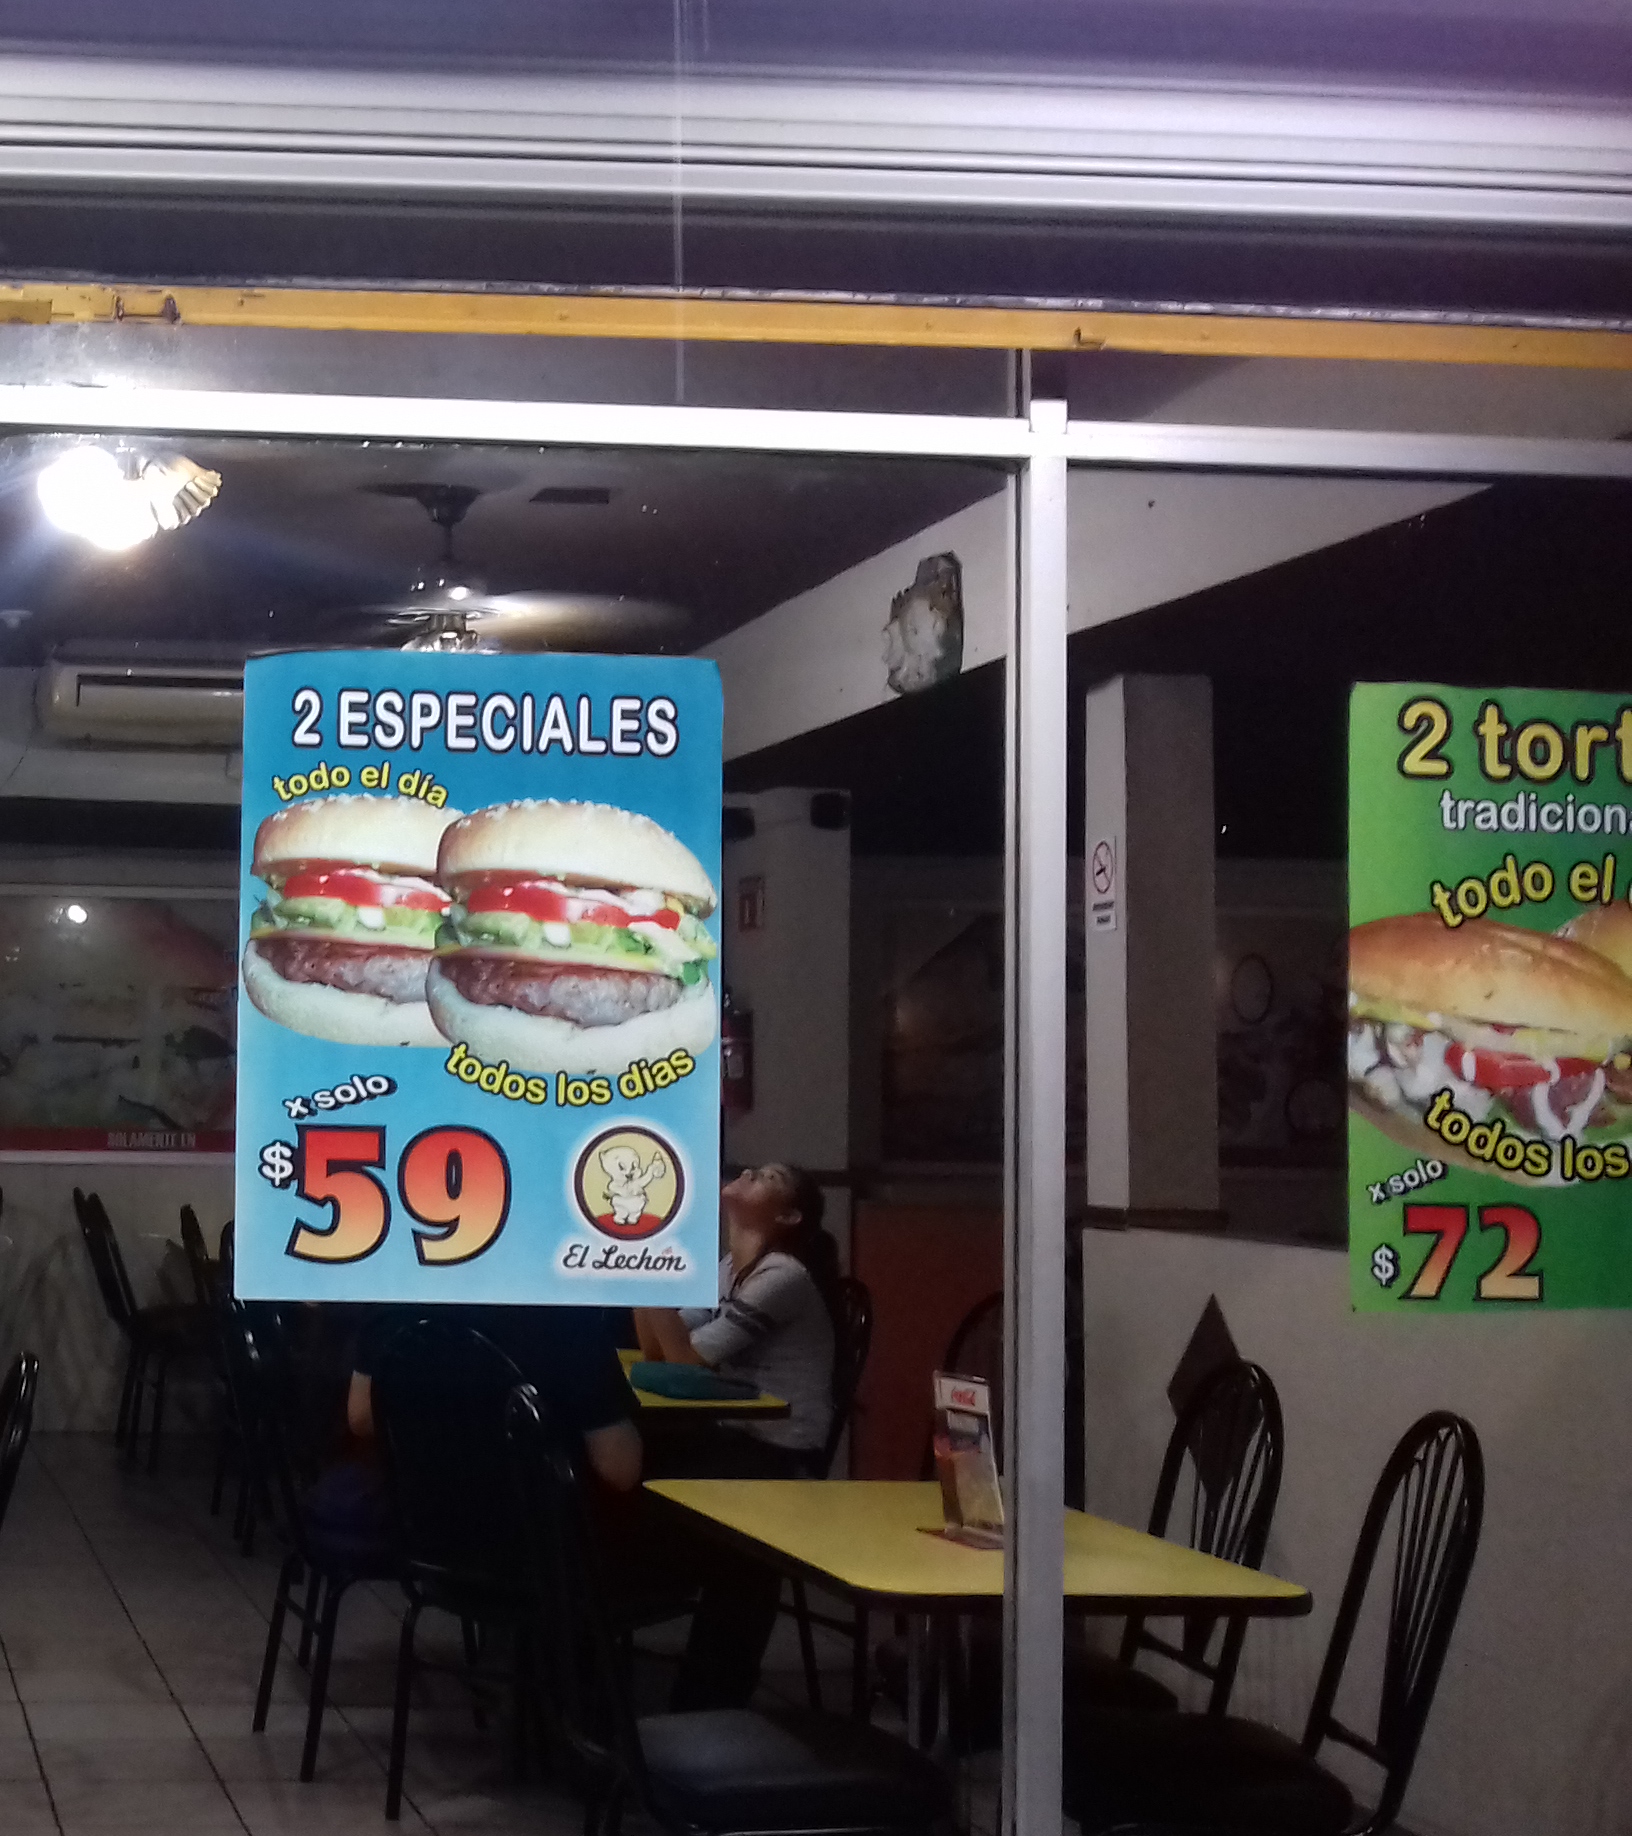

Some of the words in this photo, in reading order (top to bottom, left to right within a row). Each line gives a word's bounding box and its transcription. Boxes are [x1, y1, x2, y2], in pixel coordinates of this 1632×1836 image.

[292, 686, 323, 748] 2
[337, 687, 679, 757] ESPECIALES
[1398, 697, 1452, 780] 2
[1473, 699, 1632, 785] tort
[272, 760, 351, 801] todo
[359, 760, 390, 789] el
[397, 769, 448, 809] día
[1439, 790, 1632, 835] tradicion
[1431, 852, 1555, 929] todo
[1568, 852, 1616, 906] el
[283, 1097, 311, 1119] x
[312, 1074, 393, 1110] solo
[445, 1042, 548, 1104] todos
[556, 1070, 613, 1107] los
[618, 1048, 695, 1099] dias
[1424, 1087, 1552, 1177] todos
[1560, 1133, 1631, 1181] los
[1367, 1181, 1387, 1204] x
[1387, 1158, 1447, 1197] solo
[561, 1243, 590, 1268] El
